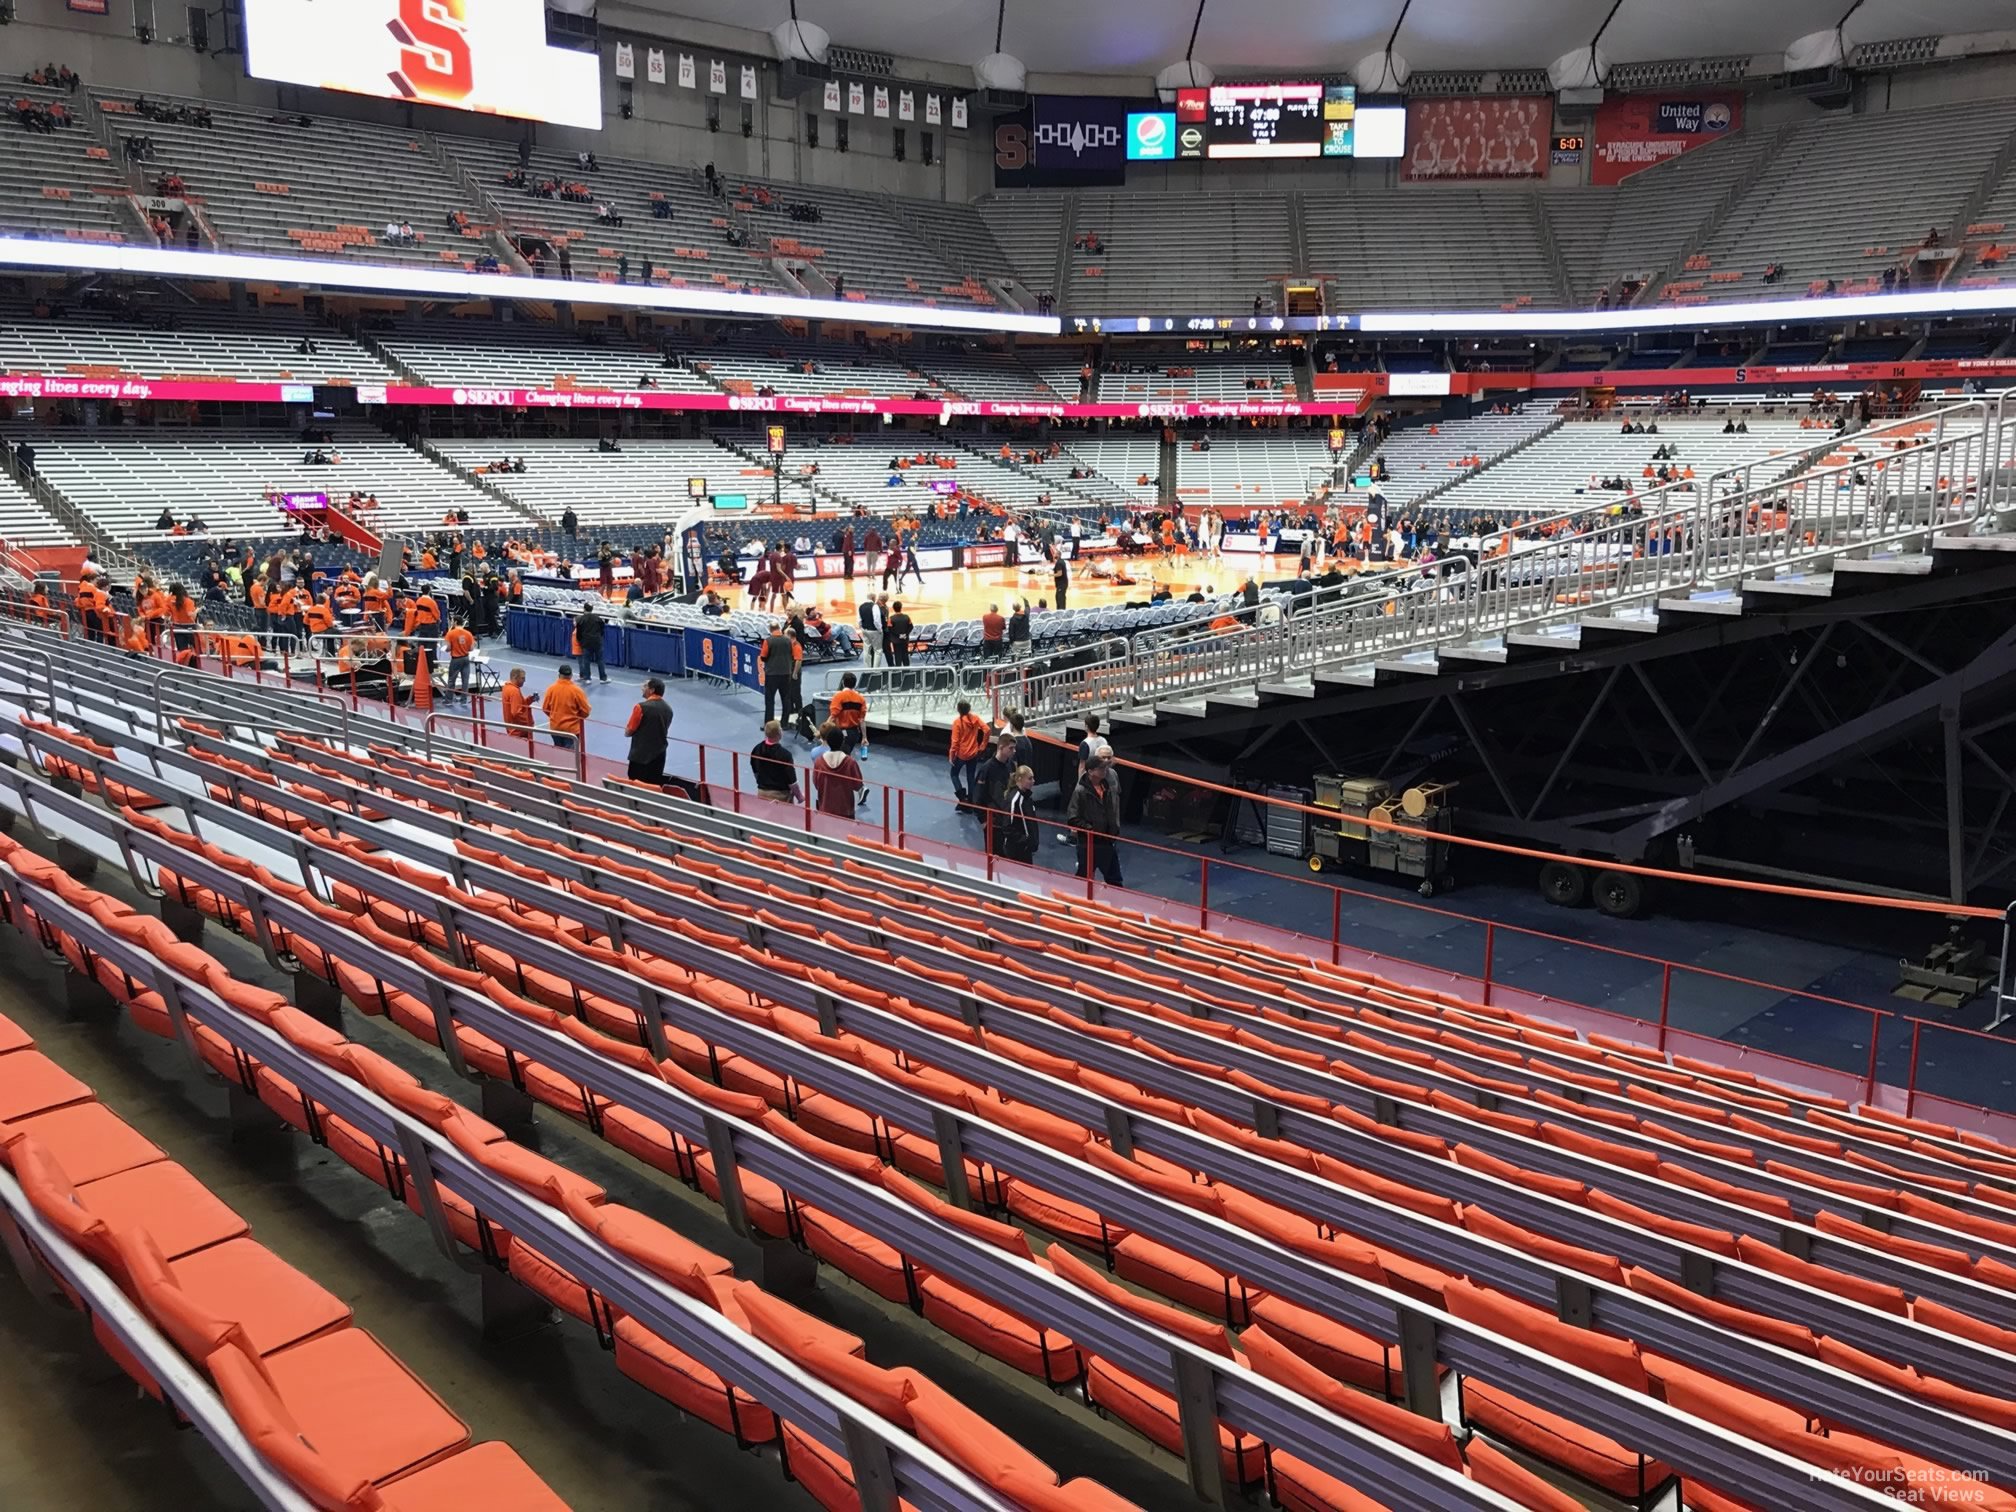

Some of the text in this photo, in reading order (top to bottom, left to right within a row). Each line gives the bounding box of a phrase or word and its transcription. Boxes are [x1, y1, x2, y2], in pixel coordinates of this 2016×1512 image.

[650, 62, 663, 73] 55
[682, 67, 692, 79] 17
[712, 73, 724, 84] 30
[745, 81, 752, 92] 4
[827, 91, 838, 102] 44
[876, 99, 887, 109] 20
[902, 102, 911, 112] 31
[928, 105, 939, 116] 22
[1660, 104, 1700, 117] United
[1329, 122, 1349, 130] TAKE
[1675, 118, 1699, 132] Way
[995, 124, 1027, 169] S
[1333, 137, 1344, 145] TO
[1560, 138, 1583, 149] 6:07
[1324, 144, 1352, 154] CROUSE
[1736, 368, 1746, 383] S
[45, 378, 78, 394] lives
[81, 382, 119, 398] every
[122, 381, 152, 399] day.
[468, 390, 514, 405] SEFCU
[525, 392, 572, 407] Changing
[573, 392, 596, 404] lives
[597, 395, 621, 408] every
[740, 398, 777, 410] SEFCU
[784, 400, 820, 412] Changing
[822, 399, 840, 410] lives
[840, 401, 860, 413] every
[1149, 404, 1188, 416] SEFCU
[1198, 404, 1239, 416] Changing
[1239, 404, 1260, 413] lives
[1260, 406, 1283, 416] every
[703, 638, 714, 667] S
